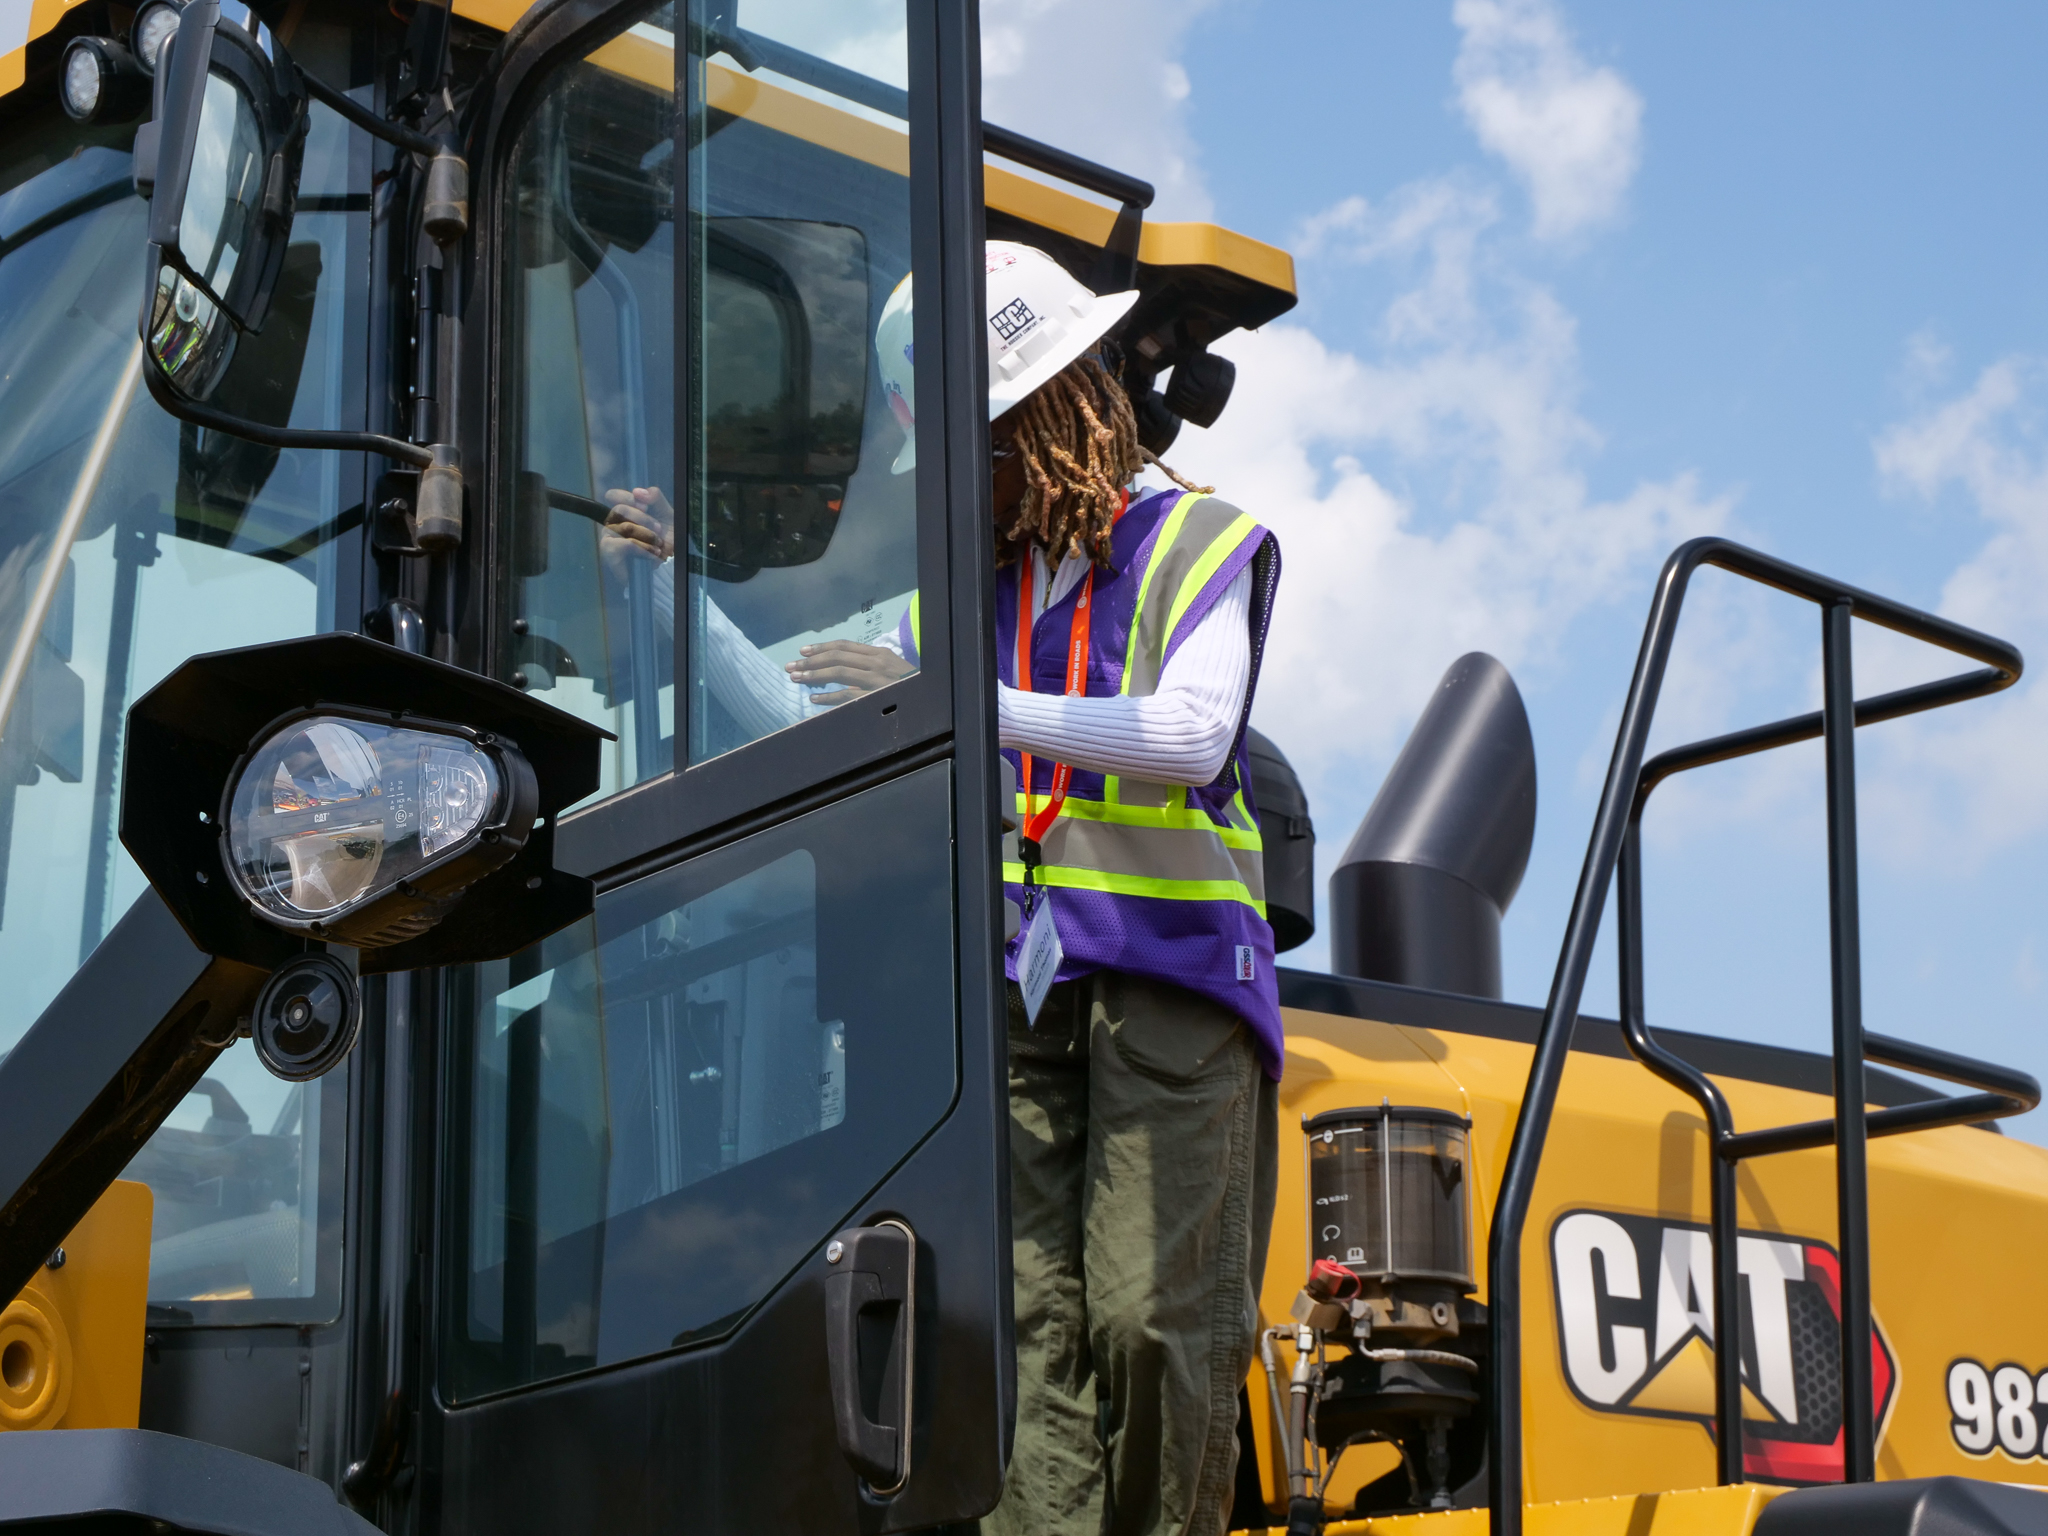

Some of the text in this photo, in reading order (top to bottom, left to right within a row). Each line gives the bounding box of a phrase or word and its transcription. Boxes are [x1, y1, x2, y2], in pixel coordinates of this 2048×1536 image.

[1072, 640, 1082, 690] WORK IN ROADS
[314, 812, 328, 823] CAT
[1554, 1213, 1805, 1425] CAT
[1949, 1361, 2048, 1455] 98
